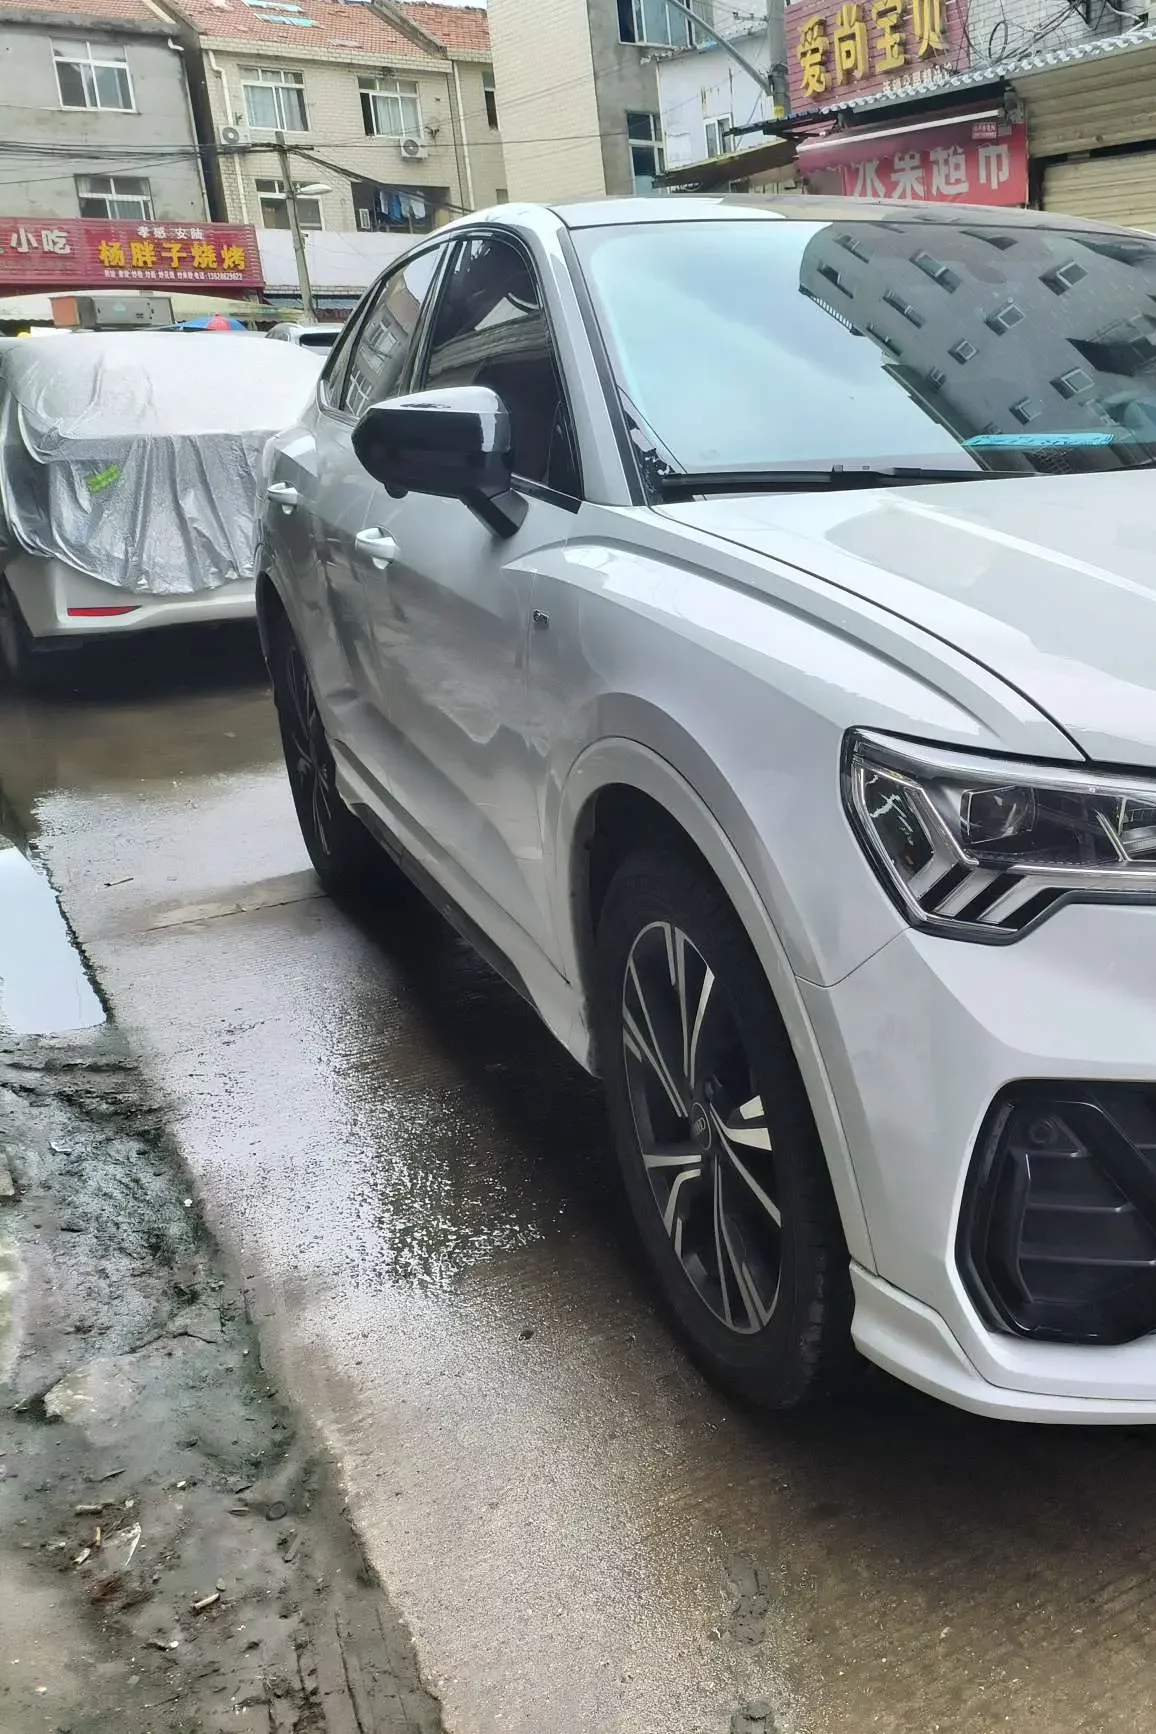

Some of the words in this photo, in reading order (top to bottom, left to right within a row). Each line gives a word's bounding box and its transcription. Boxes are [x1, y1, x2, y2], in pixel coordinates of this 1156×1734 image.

[797, 0, 950, 97] 爱尚宝贝
[852, 143, 1010, 200] 水果超市
[99, 240, 247, 270] 杨胖子烧烤
